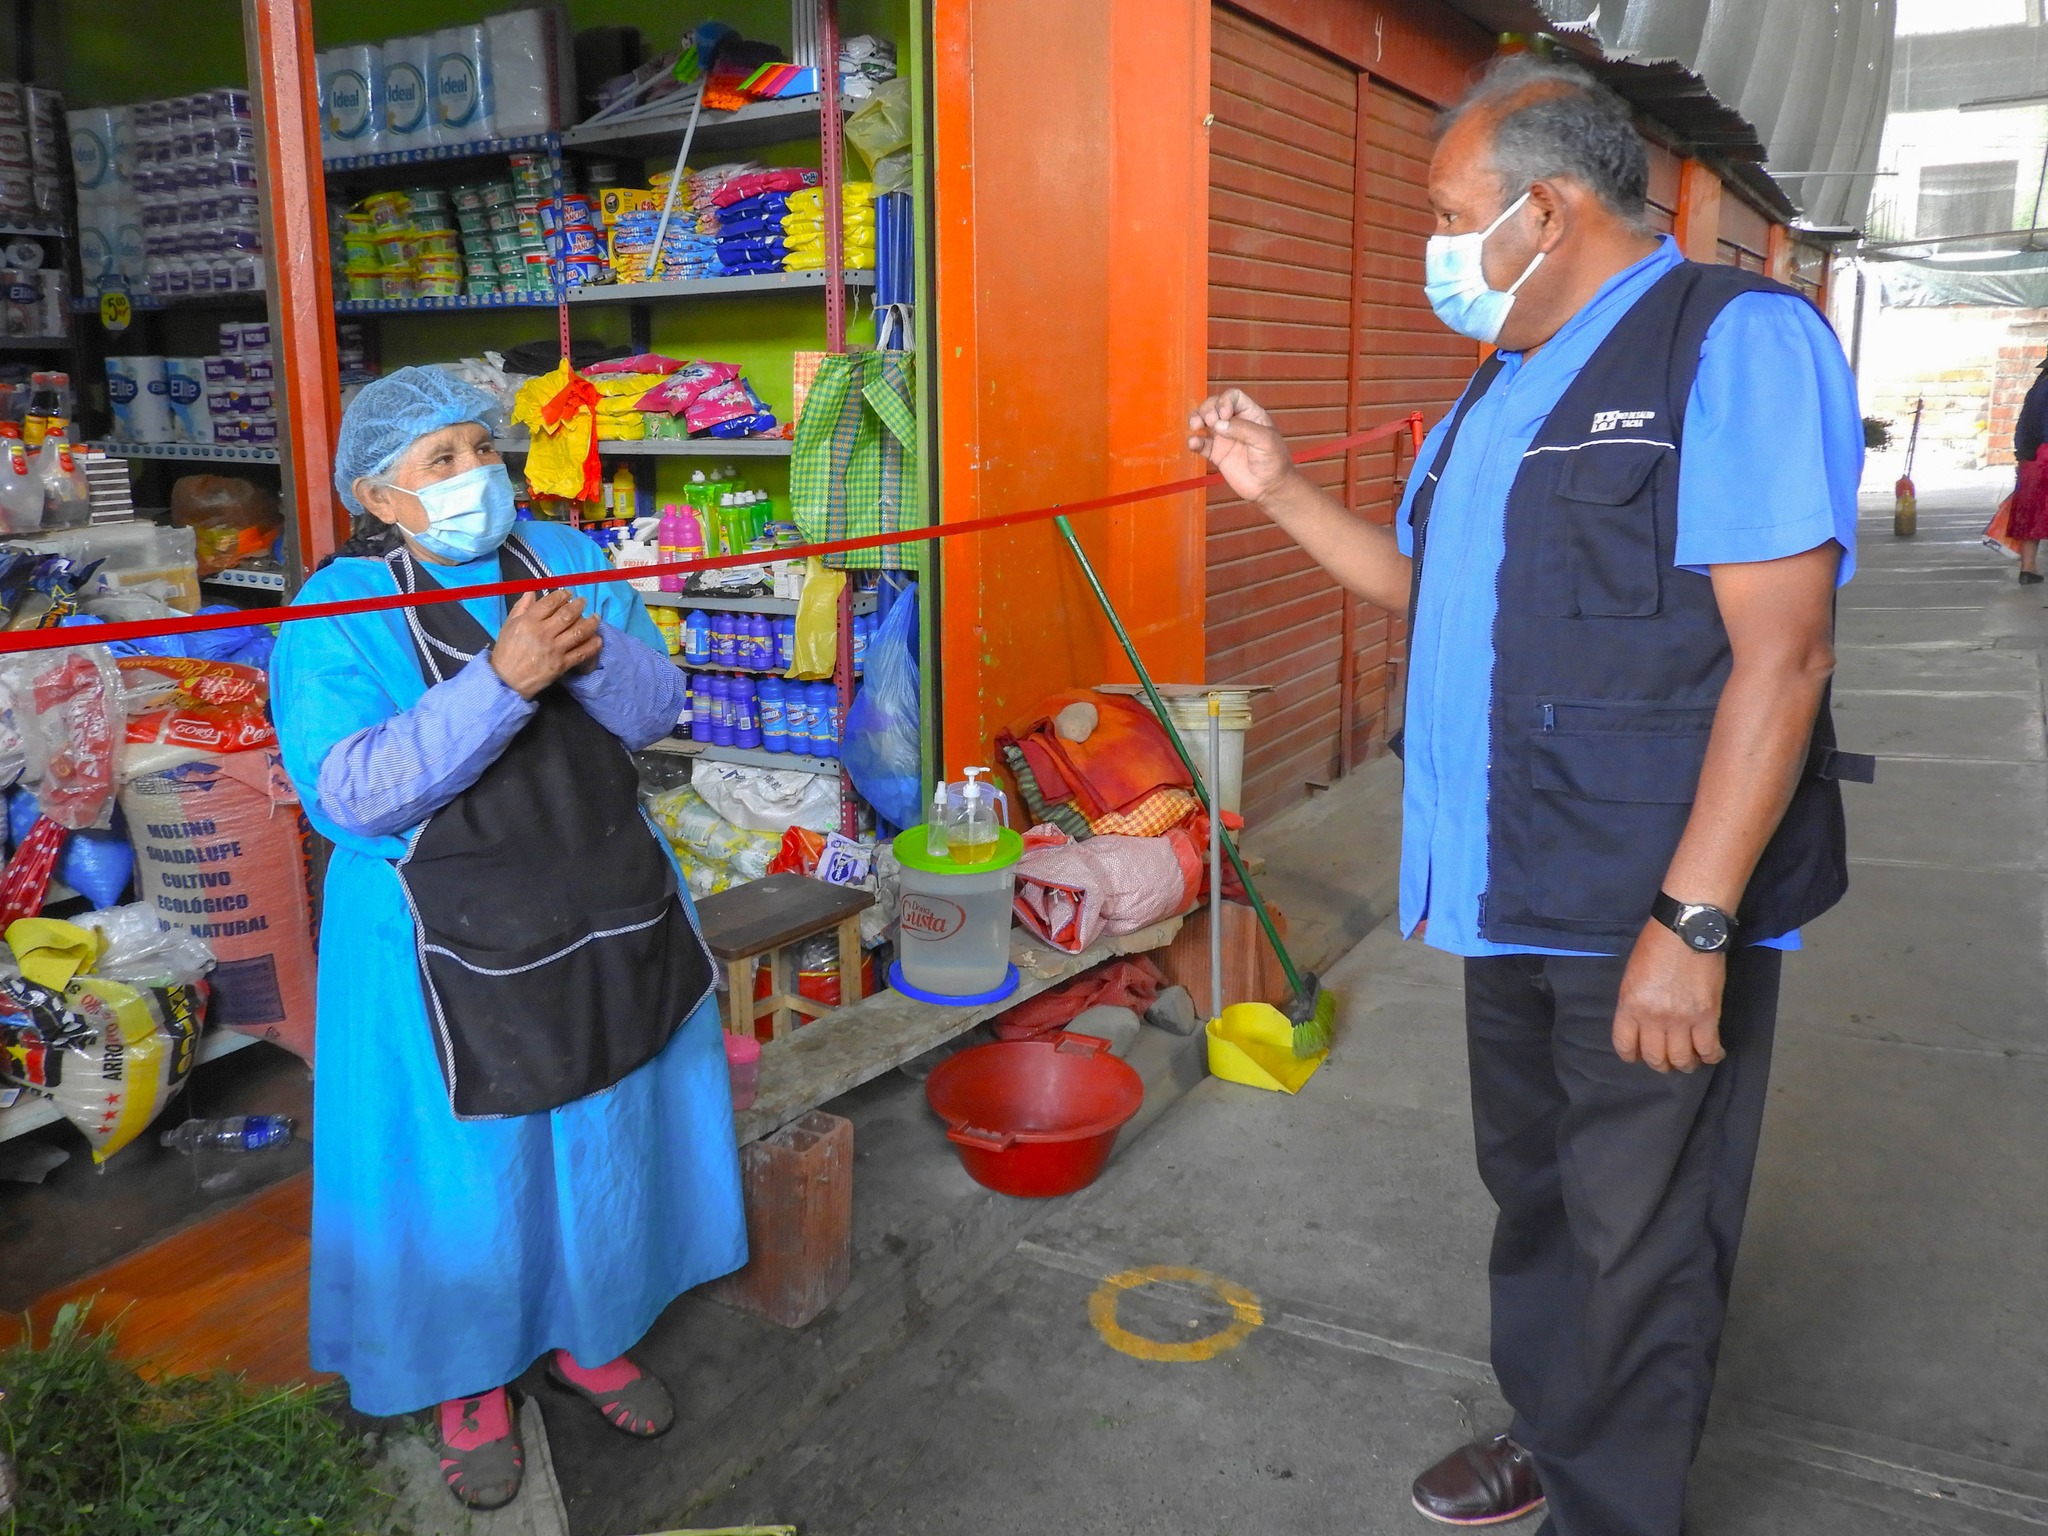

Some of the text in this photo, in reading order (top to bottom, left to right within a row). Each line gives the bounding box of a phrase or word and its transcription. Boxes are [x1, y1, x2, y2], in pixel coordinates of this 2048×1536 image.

[388, 83, 415, 103] Ideal
[440, 74, 468, 95] Ideal
[333, 88, 359, 108] Ideal
[576, 233, 587, 244] ÑA
[109, 379, 135, 396] Elite
[171, 379, 198, 397] Elite
[147, 819, 216, 839] MOLINO
[146, 841, 243, 864] GUADALUPE
[161, 871, 231, 889] CULTIVO
[157, 893, 248, 914] ECOLÓGICO
[902, 900, 947, 933] Gusta
[189, 915, 269, 939] NATURAL
